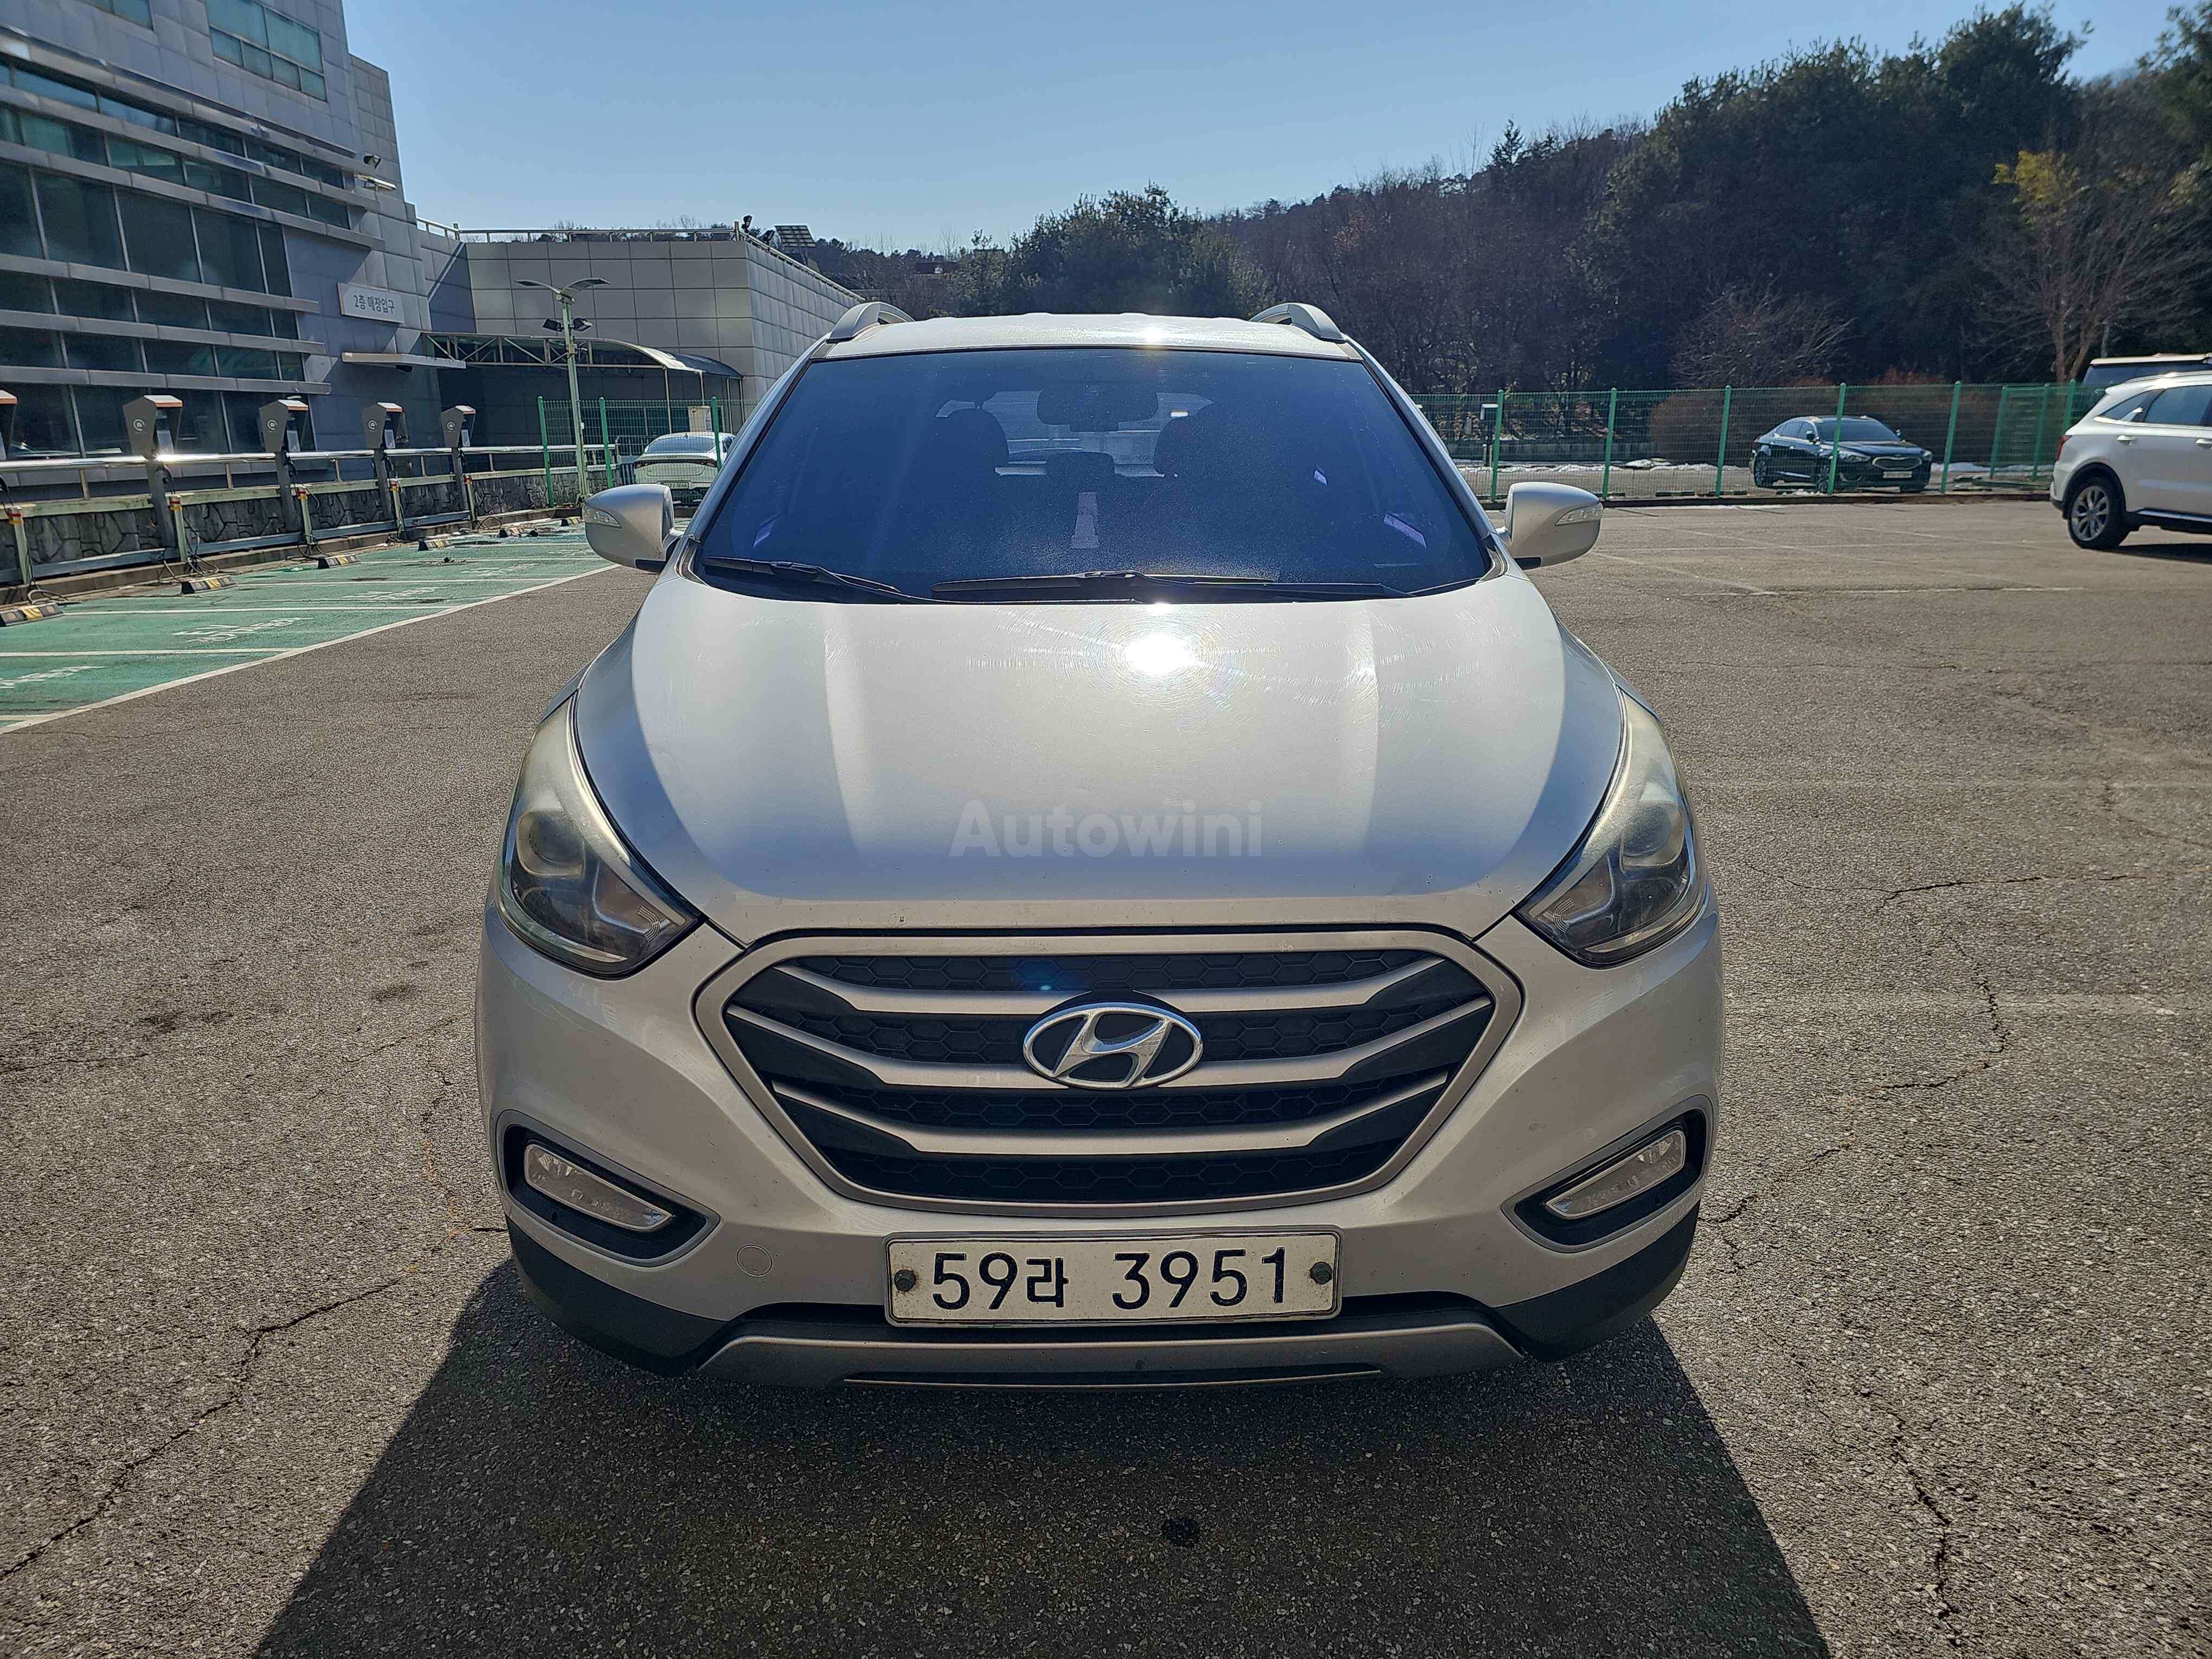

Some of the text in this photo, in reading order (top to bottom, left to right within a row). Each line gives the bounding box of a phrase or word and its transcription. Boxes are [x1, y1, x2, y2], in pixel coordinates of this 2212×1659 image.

[353, 294, 395, 314] 2층 매장입구
[931, 1246, 1286, 1310] 59라 3951
